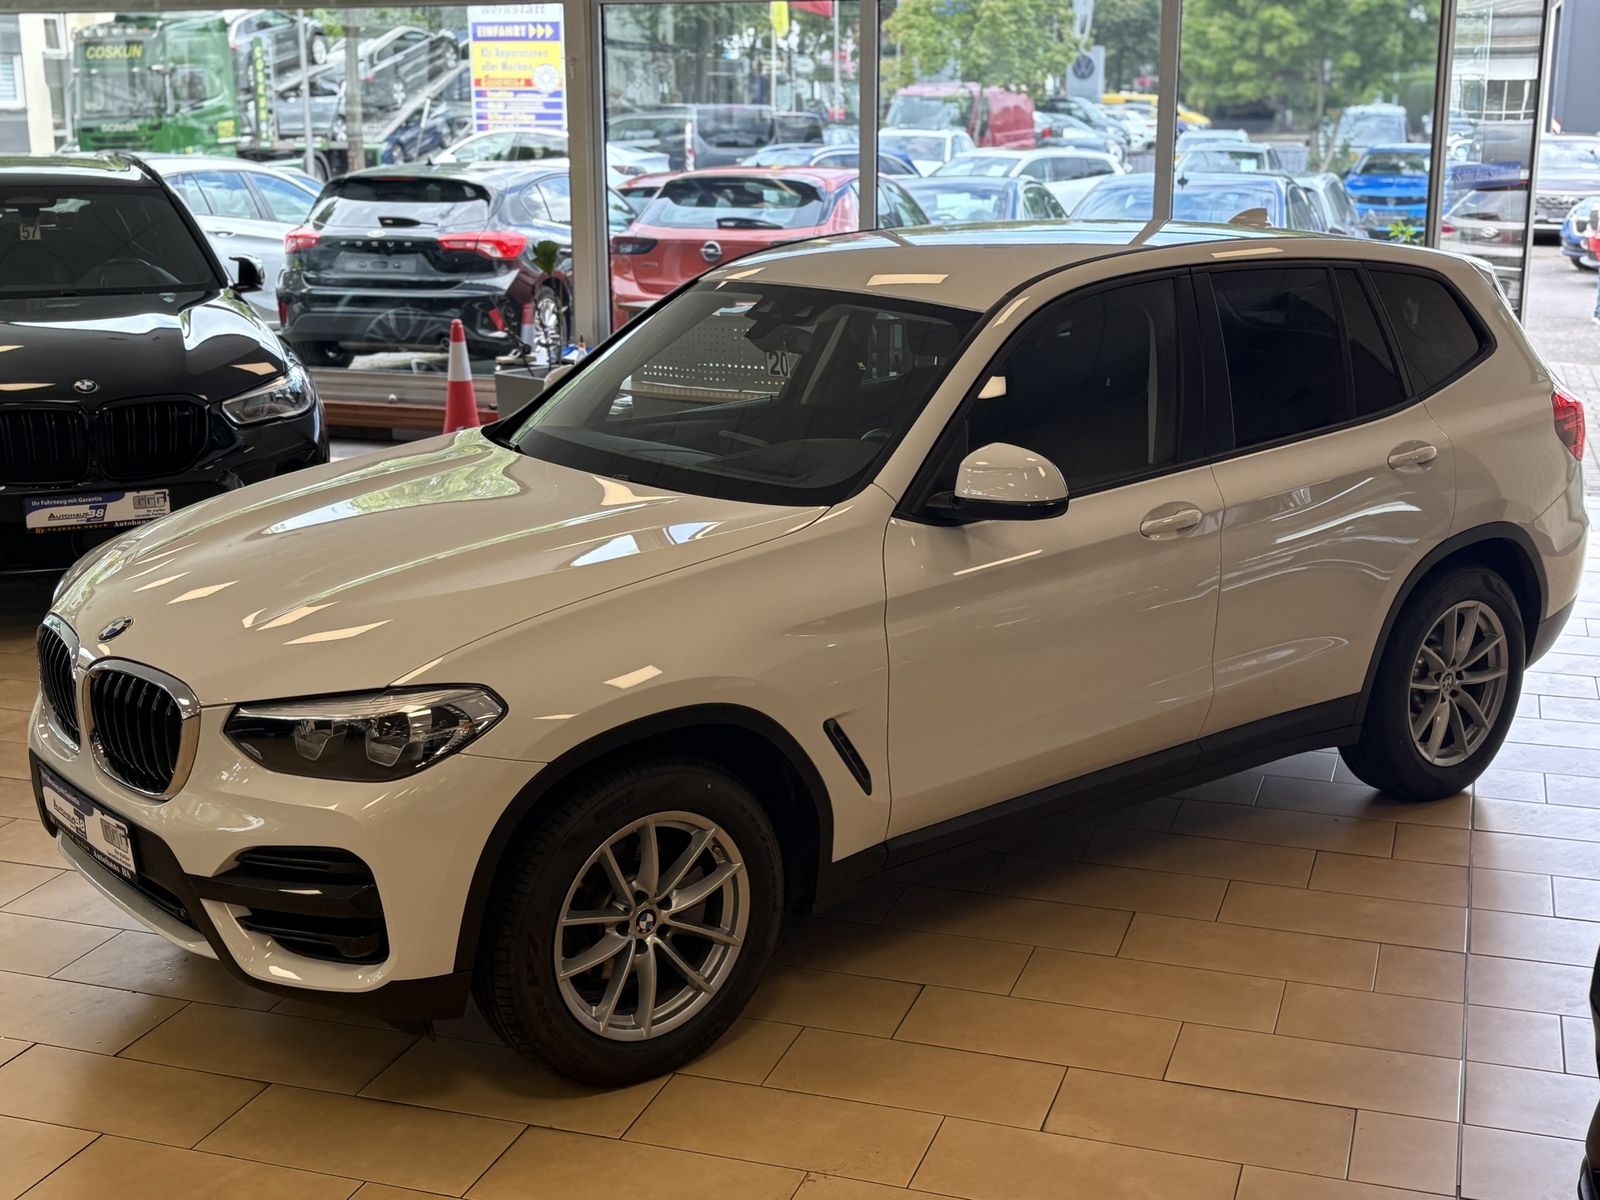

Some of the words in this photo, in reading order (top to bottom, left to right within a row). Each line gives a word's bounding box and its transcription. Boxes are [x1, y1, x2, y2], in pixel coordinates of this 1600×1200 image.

[477, 25, 526, 37] EINFAHRT
[87, 46, 142, 59] COSKUN
[21, 224, 38, 239] 57
[768, 352, 789, 377] 20
[41, 498, 67, 506] Fahrzeug
